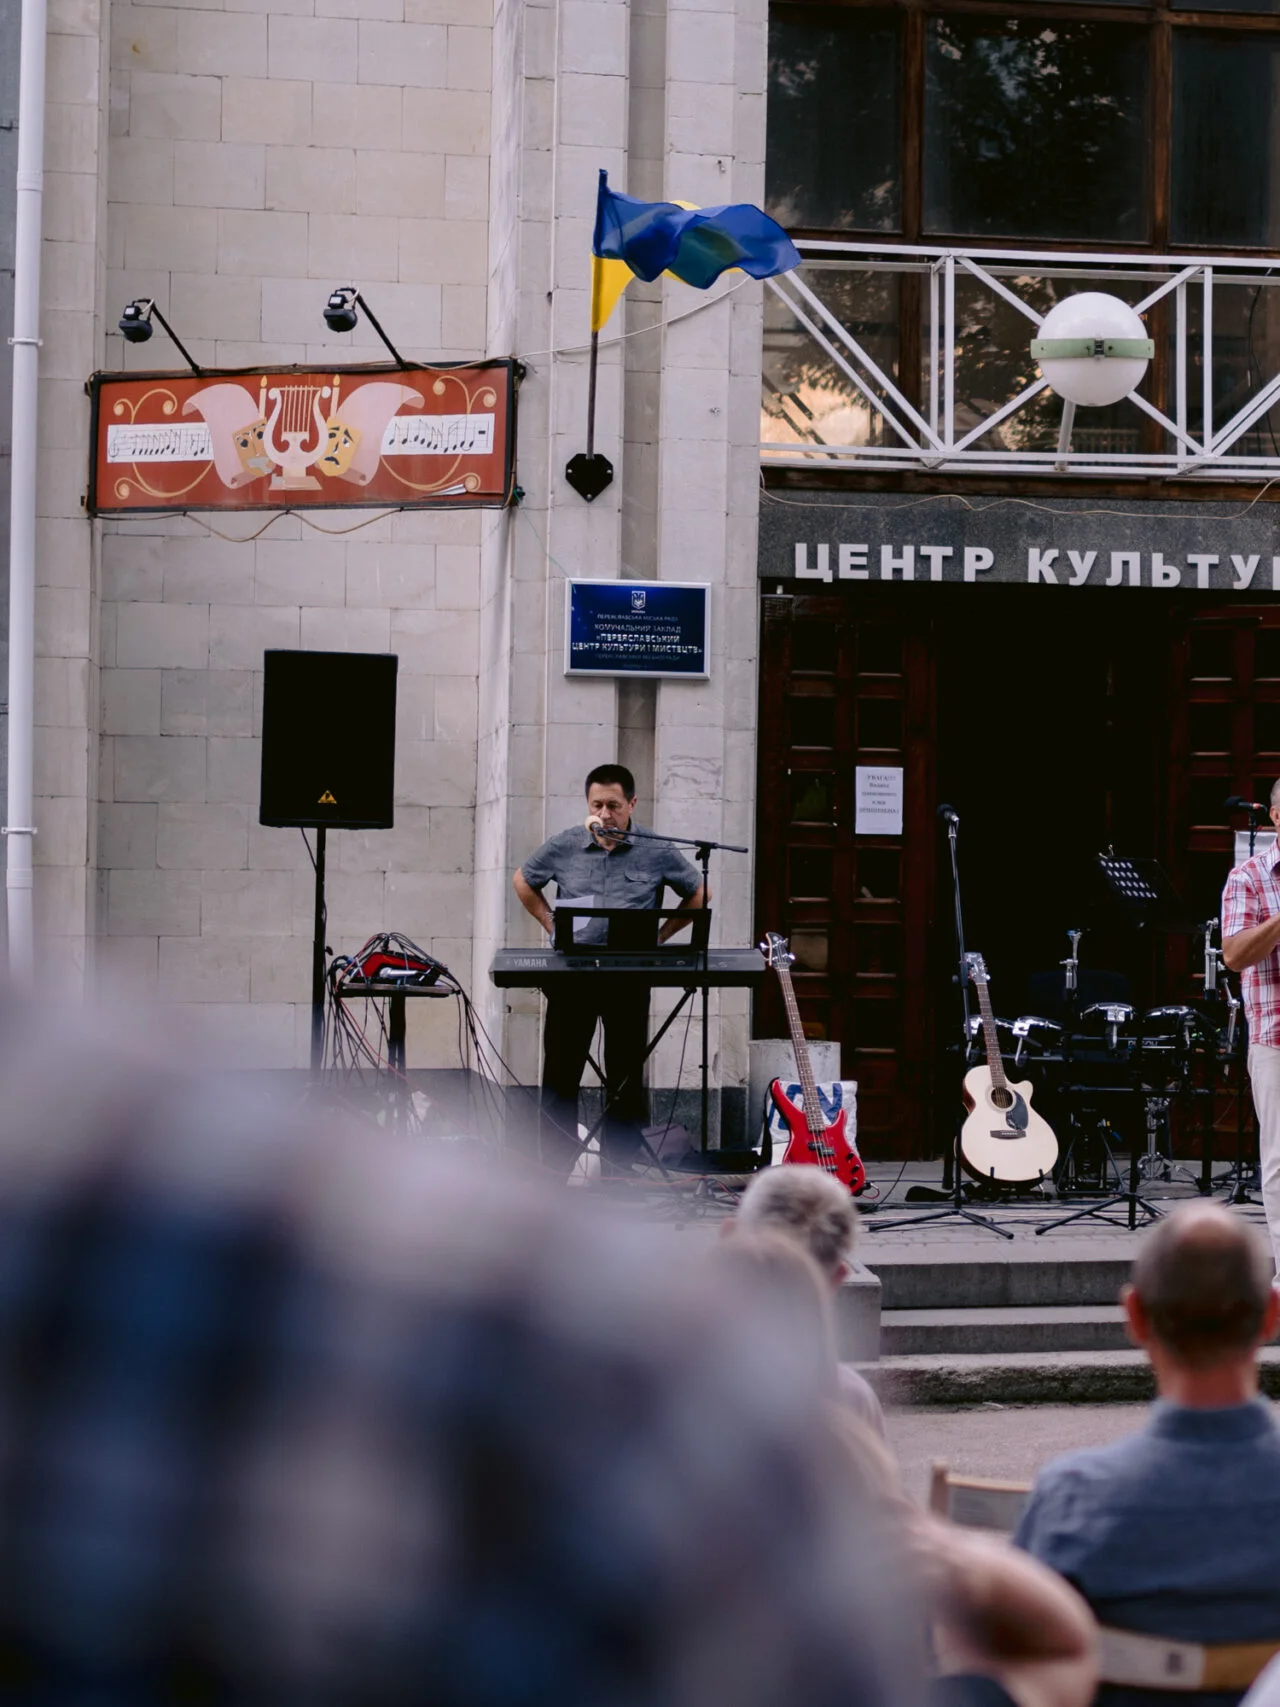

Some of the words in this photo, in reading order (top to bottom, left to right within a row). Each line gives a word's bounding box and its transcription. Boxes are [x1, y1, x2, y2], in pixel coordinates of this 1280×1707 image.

[795, 542, 995, 583] ЦЕНТР
[653, 625, 681, 633] ЗАКЛАД
[572, 642, 600, 651] ЦЕНТР
[601, 643, 646, 652] КУЛЬТУРИ
[513, 958, 548, 968] YAMAHA
